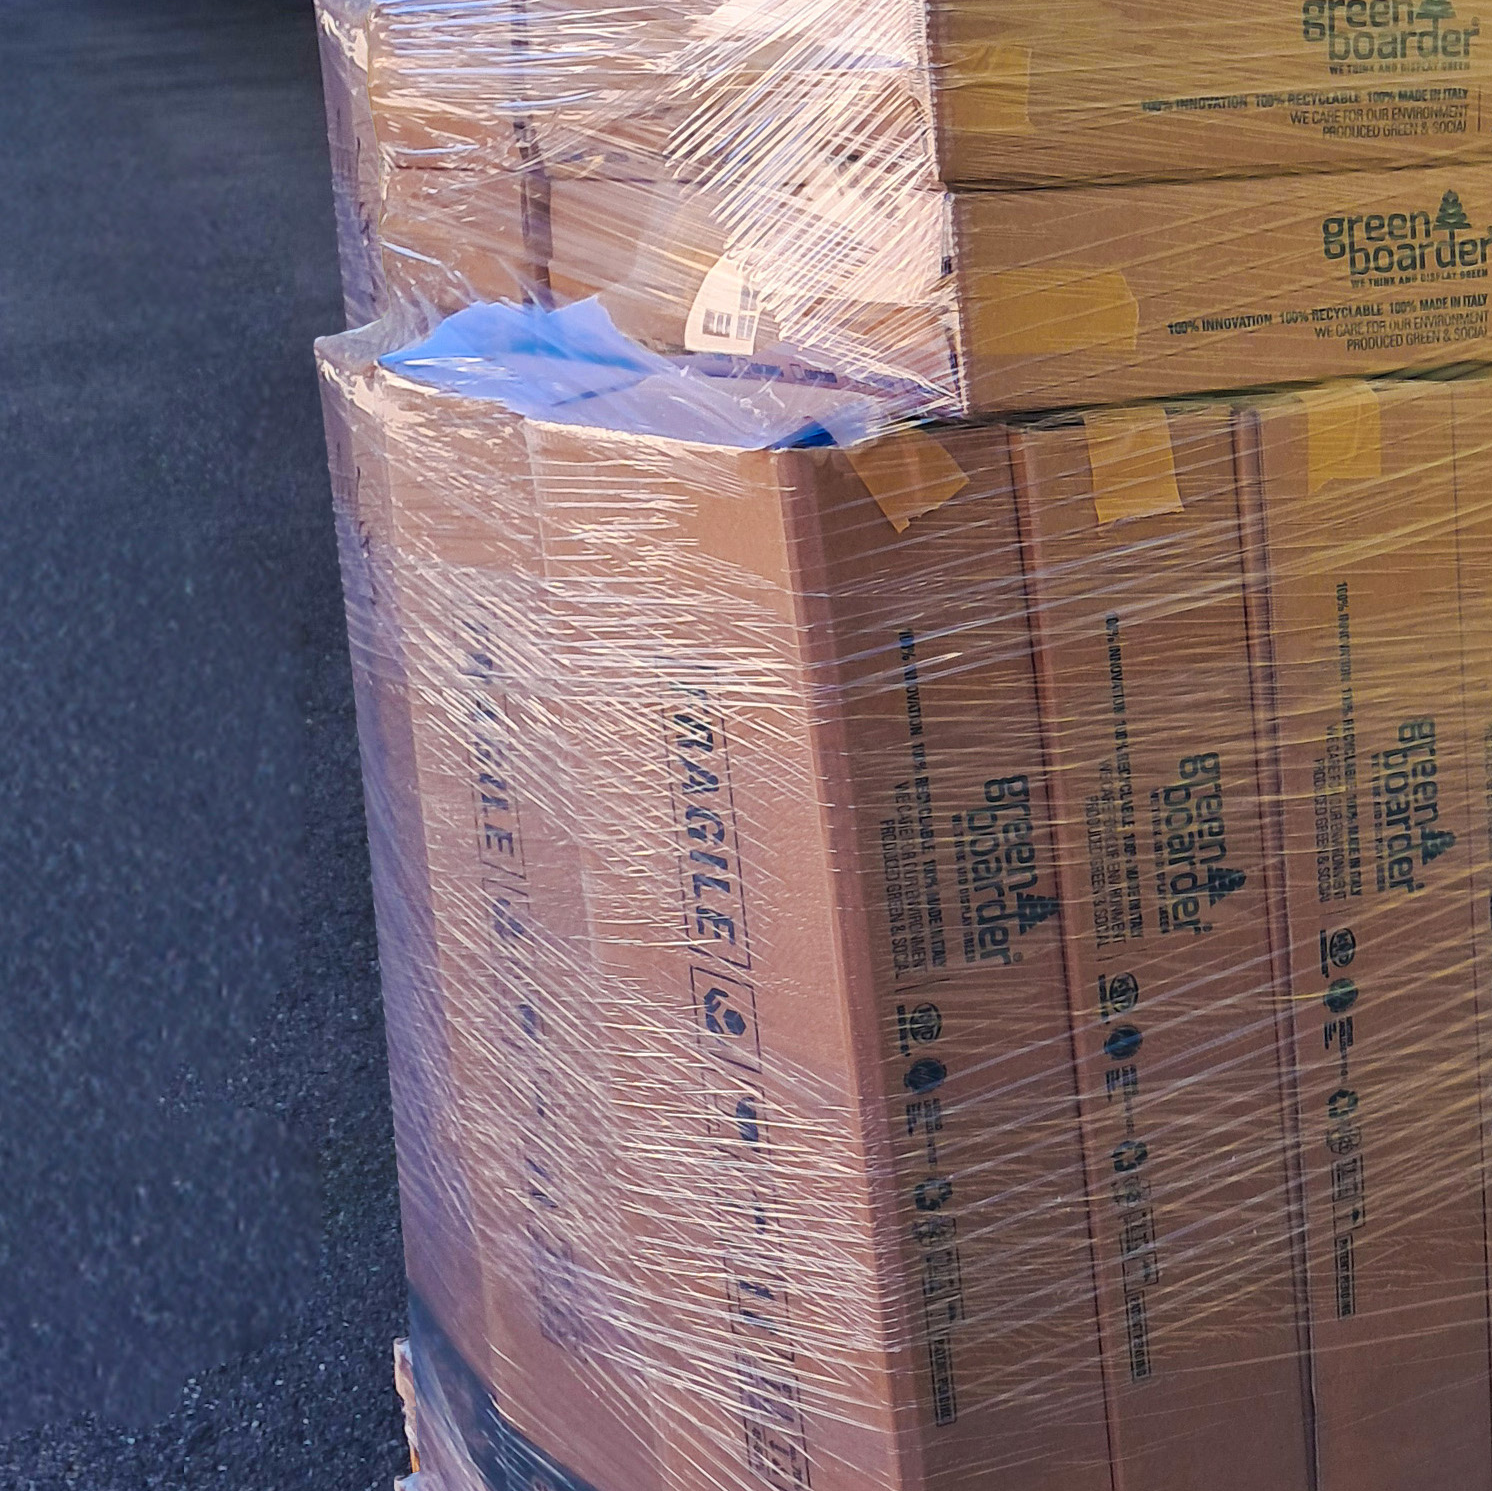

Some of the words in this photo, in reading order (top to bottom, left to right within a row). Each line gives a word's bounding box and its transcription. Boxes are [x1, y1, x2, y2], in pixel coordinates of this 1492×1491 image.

[1328, 19, 1480, 60] boarder
[1255, 93, 1286, 109] 100%
[1288, 91, 1360, 107] RECYCLABLE
[1367, 90, 1395, 104] 100%
[1290, 111, 1309, 125] WE
[1312, 110, 1340, 125] CARE
[1343, 109, 1363, 124] FOR
[1366, 108, 1390, 123] OUR
[1392, 104, 1469, 121] ENVIRONMENT
[1322, 123, 1380, 140] PRODUCED
[1322, 210, 1432, 260] green
[1167, 320, 1200, 336] 100%
[1201, 314, 1272, 332] INNOVATION
[1279, 310, 1309, 325] 100%
[1312, 304, 1384, 322] RECYCLABLE
[1389, 301, 1417, 315] 100%
[1419, 298, 1449, 312] MADE
[1450, 297, 1461, 310] IN
[1462, 294, 1488, 308] ITALY
[1314, 326, 1333, 341] WE
[1335, 323, 1364, 338] CARE
[1366, 321, 1387, 336] FOR
[1389, 319, 1412, 334] OUR
[1413, 312, 1489, 331] ENVIRONMENT
[1346, 334, 1404, 352] PRODUCED
[1406, 331, 1441, 347] GREEN
[1443, 329, 1452, 343] &
[1398, 720, 1440, 825] green
[1178, 752, 1229, 864] green
[1382, 748, 1418, 894] boarder
[983, 776, 1039, 892] green
[1163, 784, 1206, 934] boarder
[966, 808, 1014, 964] boarder
